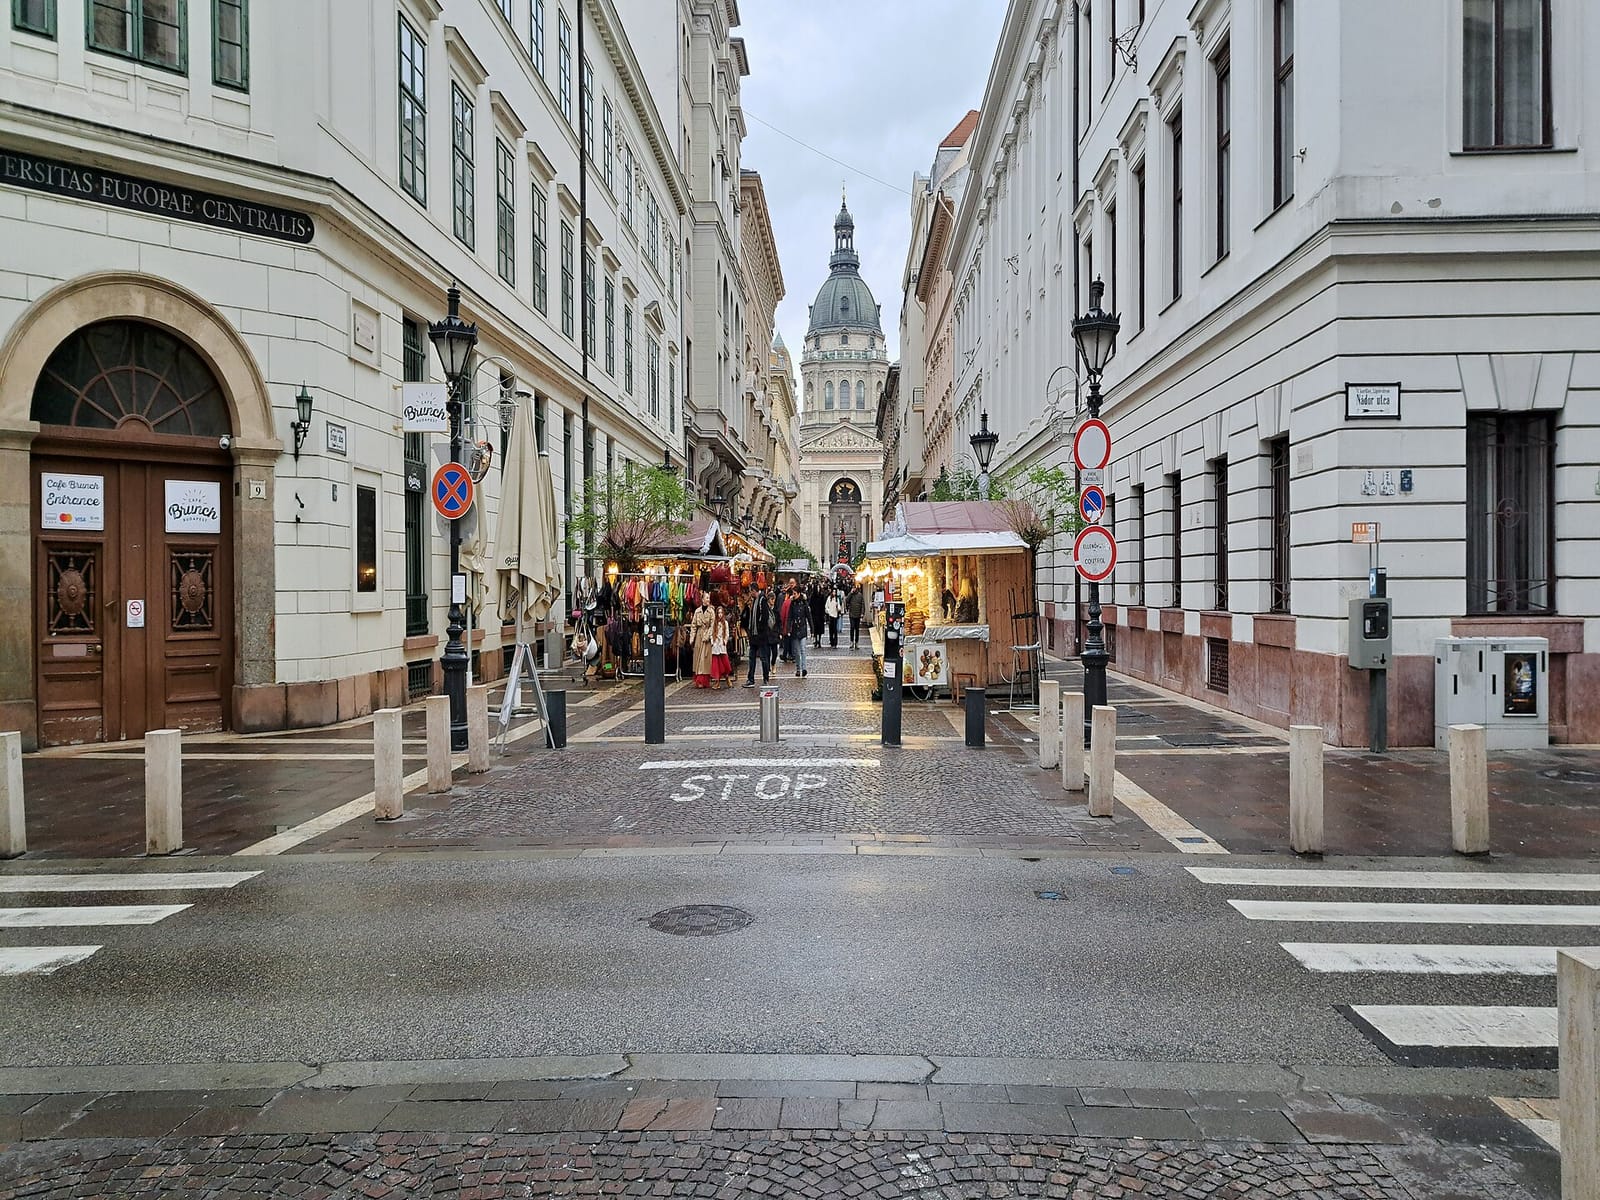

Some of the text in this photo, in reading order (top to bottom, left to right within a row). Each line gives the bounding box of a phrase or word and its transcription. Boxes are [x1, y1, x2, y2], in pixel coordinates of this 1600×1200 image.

[0, 155, 306, 237] ERSITAS EUROPAE CENTRALIS
[403, 405, 447, 421] Brunch
[46, 479, 100, 490] Cafe Brunch
[255, 486, 261, 496] 9
[46, 492, 101, 506] Entrance
[168, 503, 218, 520] Brunch
[669, 773, 828, 802] STOP
